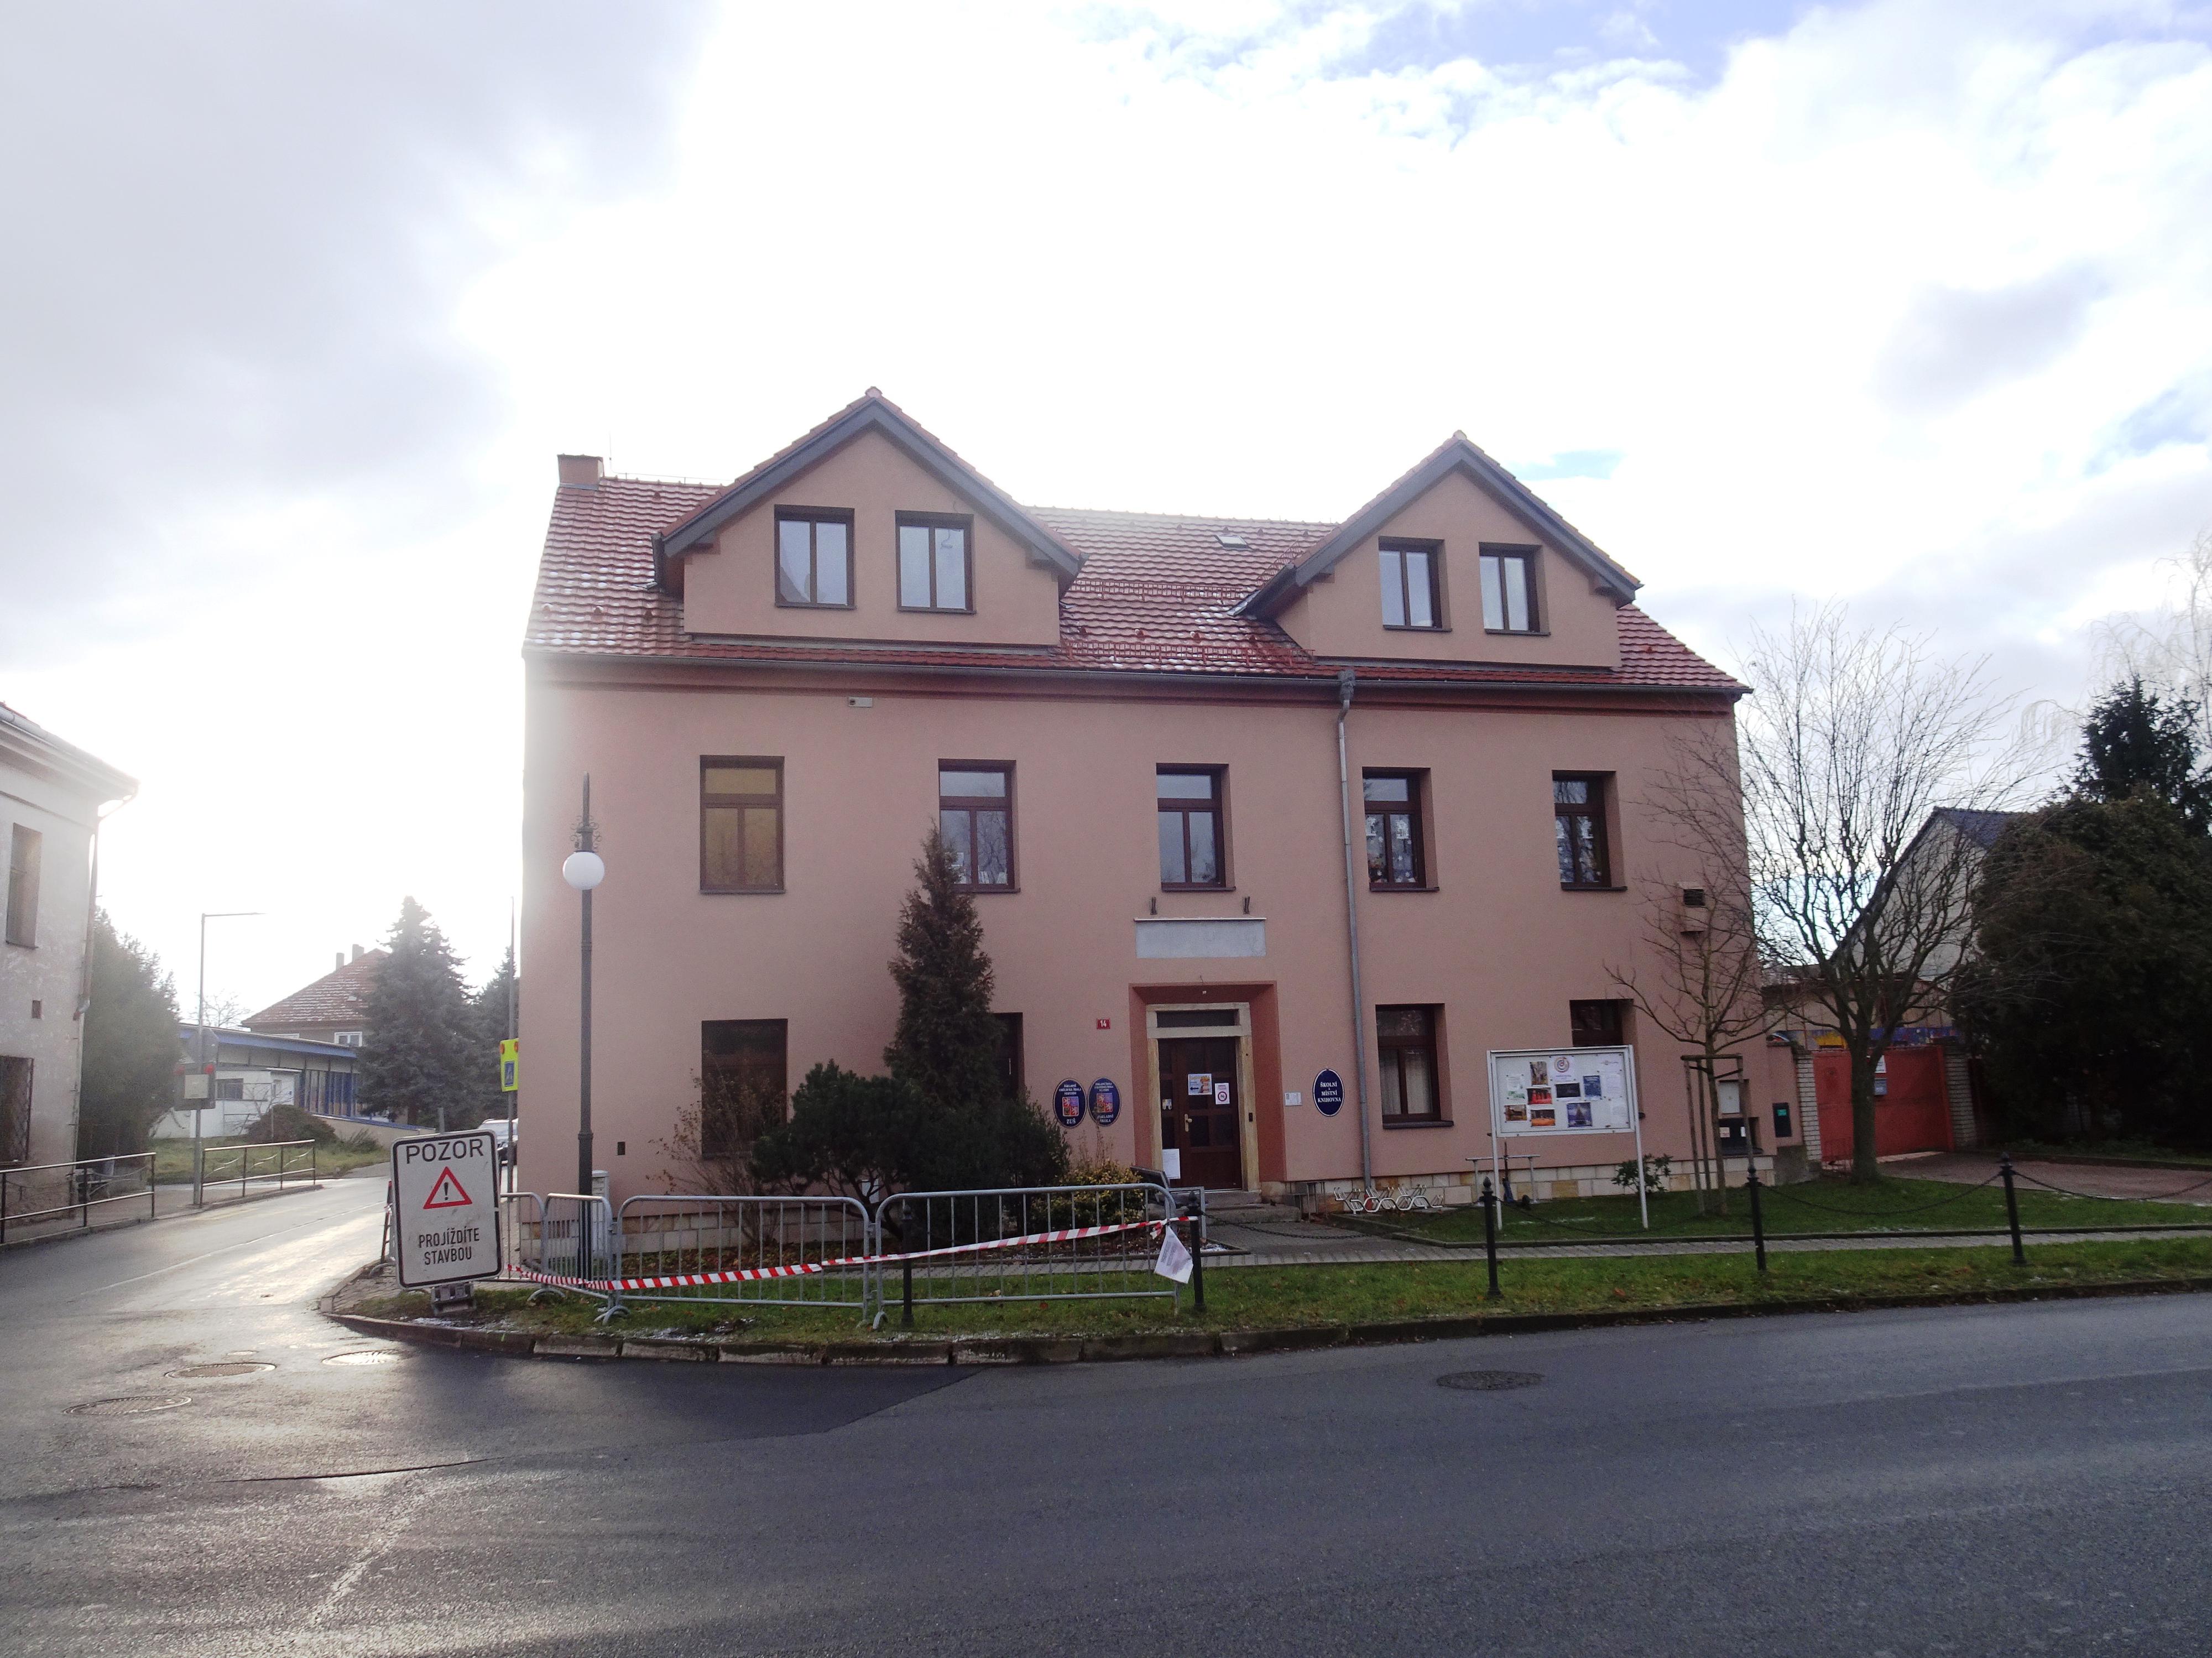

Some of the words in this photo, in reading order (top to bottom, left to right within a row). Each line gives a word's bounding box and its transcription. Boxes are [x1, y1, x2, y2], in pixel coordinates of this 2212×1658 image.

[406, 1138, 484, 1164] POZOR
[419, 1226, 479, 1248] PROJÍŽDÍTE
[424, 1246, 472, 1265] STAVBOU
